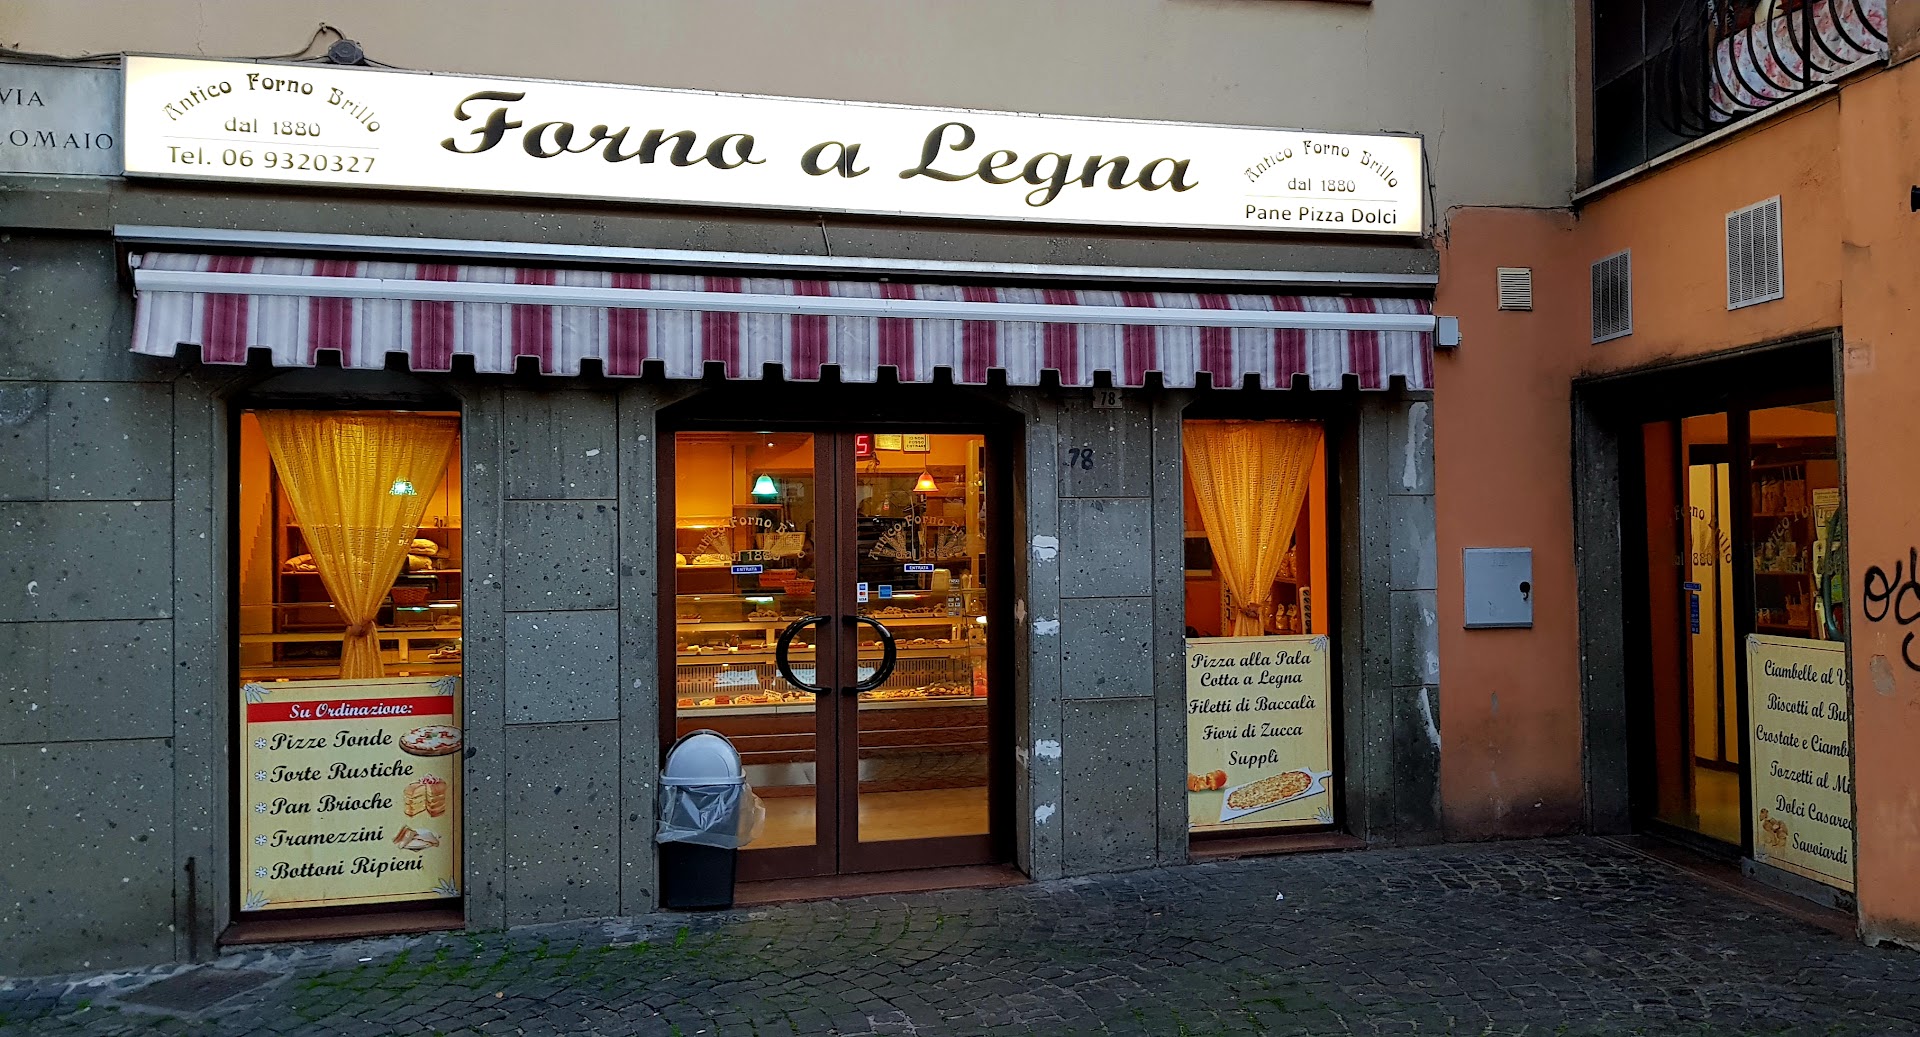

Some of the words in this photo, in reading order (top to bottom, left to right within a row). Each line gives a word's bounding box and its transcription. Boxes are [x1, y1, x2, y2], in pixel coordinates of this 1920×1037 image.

[0, 88, 45, 107] VIA
[162, 79, 233, 122] Antico
[246, 72, 314, 96] Forno
[326, 86, 381, 135] Brillo
[224, 117, 257, 134] dal
[272, 120, 321, 138] 1880
[0, 129, 113, 150] OMAIO
[440, 90, 767, 170] Forno
[801, 139, 870, 179] a
[898, 121, 1199, 207] Legna
[166, 145, 211, 166] Tel.
[221, 148, 254, 169] 06
[263, 150, 376, 175] 9320327
[1244, 147, 1293, 183] Antico
[1302, 140, 1350, 157] Forno
[1360, 150, 1398, 188] Brillo
[1287, 178, 1311, 191] dal
[1321, 179, 1356, 193] 1880
[1246, 204, 1292, 221] Pane
[1299, 206, 1344, 223] Pizza
[1352, 208, 1396, 225] Dolci
[1101, 392, 1116, 405] 78
[1069, 448, 1094, 471] 78
[729, 515, 772, 529] Forno
[868, 522, 903, 560] Antico
[905, 514, 945, 527] Forno
[1191, 653, 1235, 669] Pizza
[1239, 651, 1271, 667] alla
[1275, 650, 1312, 666] Pala
[1200, 671, 1239, 687] Cotta
[1243, 676, 1253, 685] a
[1257, 670, 1303, 689] Legna
[1764, 659, 1818, 683] Ciambelle
[1820, 667, 1834, 686] al
[289, 704, 311, 719] Su
[315, 703, 414, 719] Ordinazione:
[1188, 698, 1232, 714] Filetti
[1235, 697, 1250, 712] di
[1254, 694, 1316, 712] Baccalà
[1767, 692, 1809, 716] Biscotti
[1811, 701, 1824, 719] al
[269, 732, 327, 751] Pizze
[332, 729, 393, 748] Tonde
[1202, 724, 1238, 740] Fiori
[1241, 723, 1256, 739] di
[1260, 722, 1303, 737] Zucca
[1756, 724, 1799, 748] Crostate
[1802, 738, 1808, 749] e
[269, 765, 321, 783] Torte
[327, 759, 414, 780] Rustiche
[1770, 760, 1813, 785] Tozzetti
[1816, 771, 1829, 788] al
[269, 797, 311, 815] Pan
[316, 792, 393, 813] Brioche
[1775, 794, 1805, 818] Dolci
[270, 825, 384, 848] Tramezzini
[1792, 832, 1848, 865] Savoiardi
[270, 860, 344, 880] Bottoni
[350, 855, 423, 878] Ripieni
